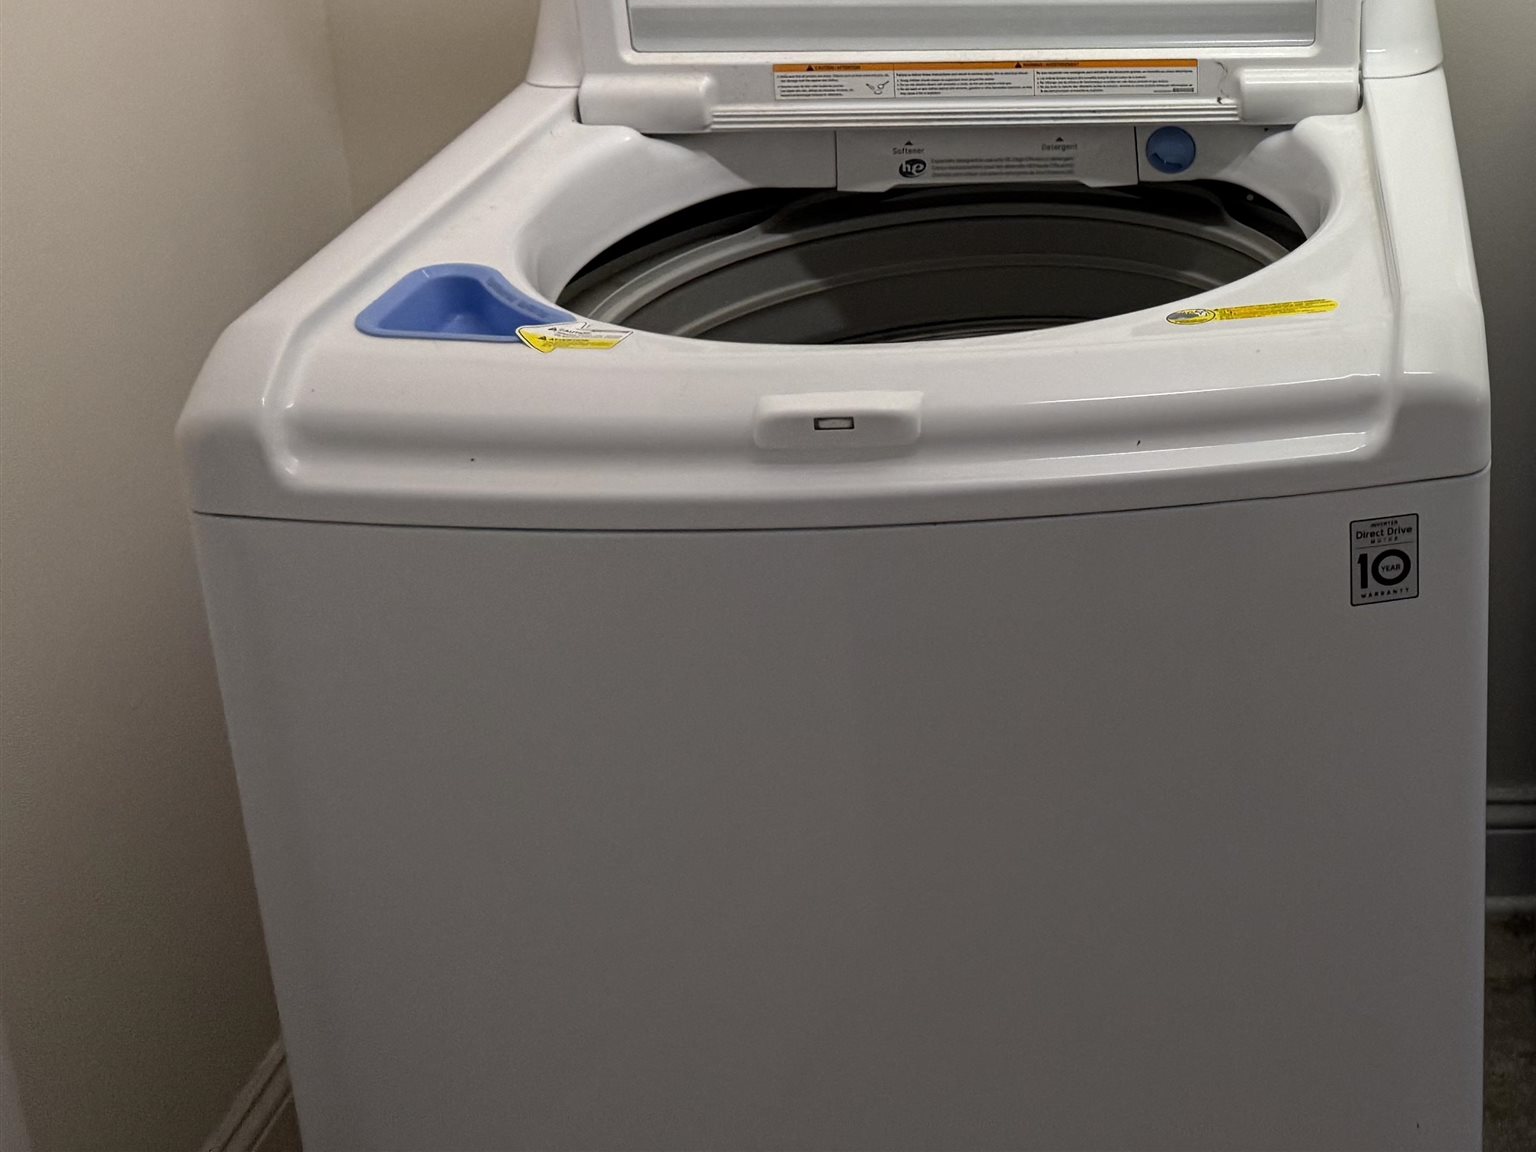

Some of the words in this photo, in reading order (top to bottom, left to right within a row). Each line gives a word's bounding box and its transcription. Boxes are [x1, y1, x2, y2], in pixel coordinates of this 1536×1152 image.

[892, 147, 925, 155] Softener
[1041, 143, 1077, 152] Detergent
[1356, 528, 1384, 540] Direct
[1387, 526, 1413, 536] Drive
[1357, 549, 1412, 589] 10
[1381, 564, 1401, 572] YEAR
[1361, 588, 1409, 599] WARRANTY
